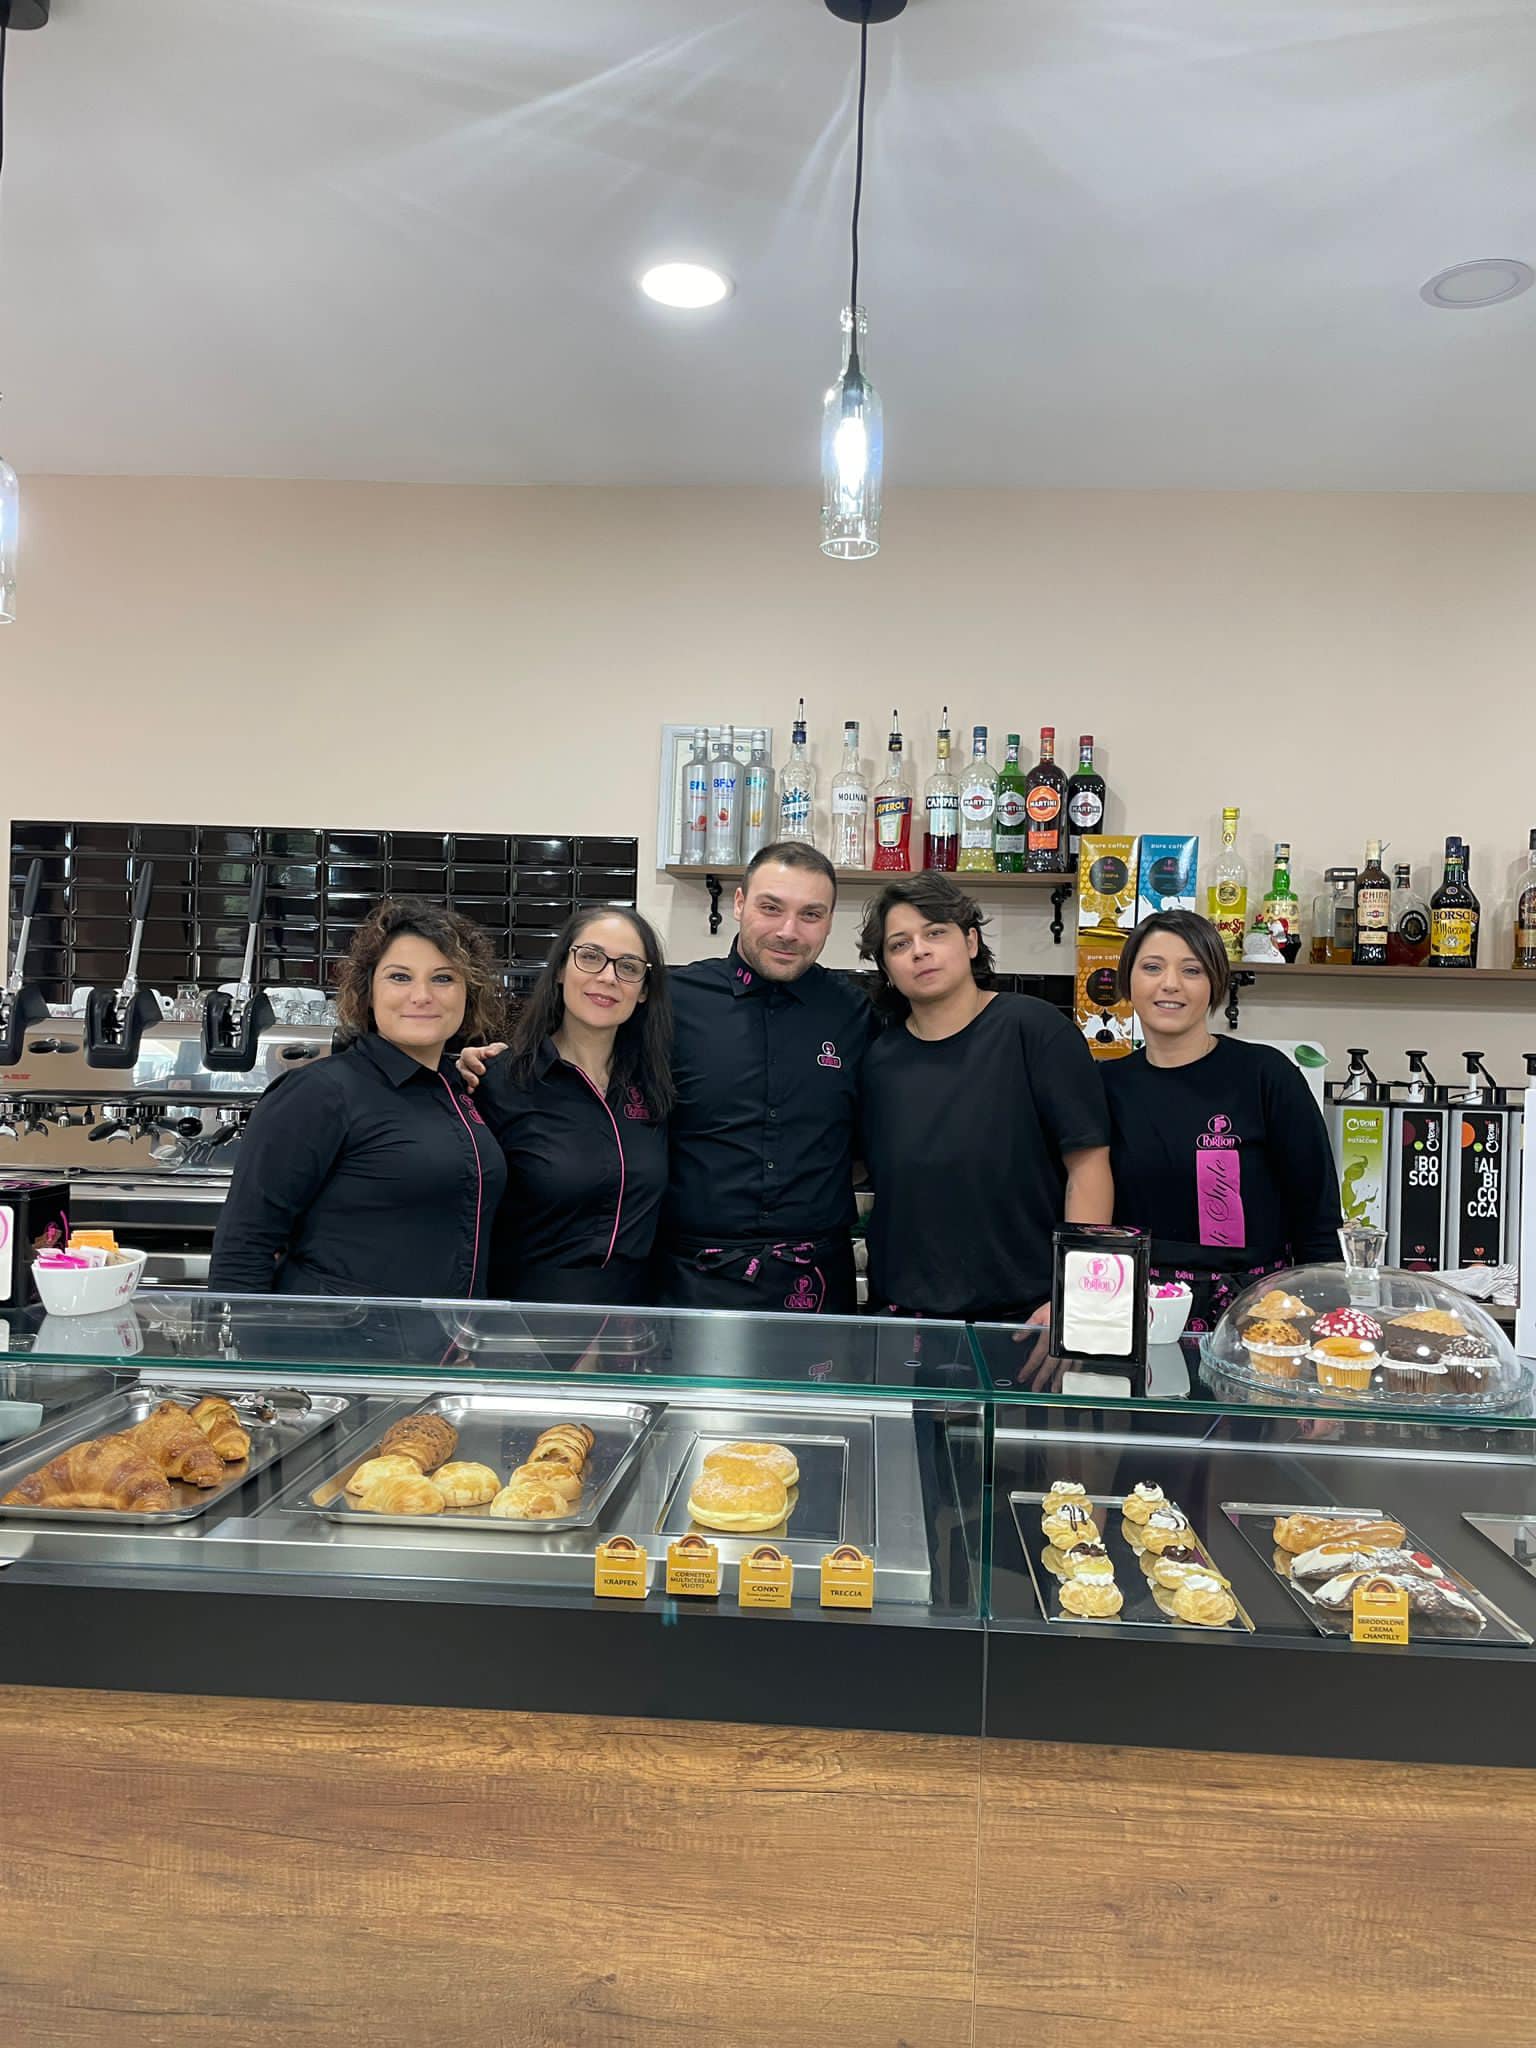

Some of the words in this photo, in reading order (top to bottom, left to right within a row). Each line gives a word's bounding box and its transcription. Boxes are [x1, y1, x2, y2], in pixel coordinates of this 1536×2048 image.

[713, 778, 736, 788] BFLY
[876, 800, 905, 814] APEROL
[963, 799, 992, 807] MARTINI
[1029, 800, 1057, 808] MARTINI
[1072, 805, 1101, 813] MARTINI
[1419, 1156, 1439, 1171] BO
[1478, 1157, 1499, 1173] AL
[1409, 1170, 1439, 1186] SCO
[1483, 1172, 1498, 1188] BI
[1477, 1187, 1498, 1202] CO
[1467, 1201, 1498, 1217] CCA
[830, 1589, 863, 1597] TRECCIA
[1362, 1633, 1401, 1641] CHANTILLY
